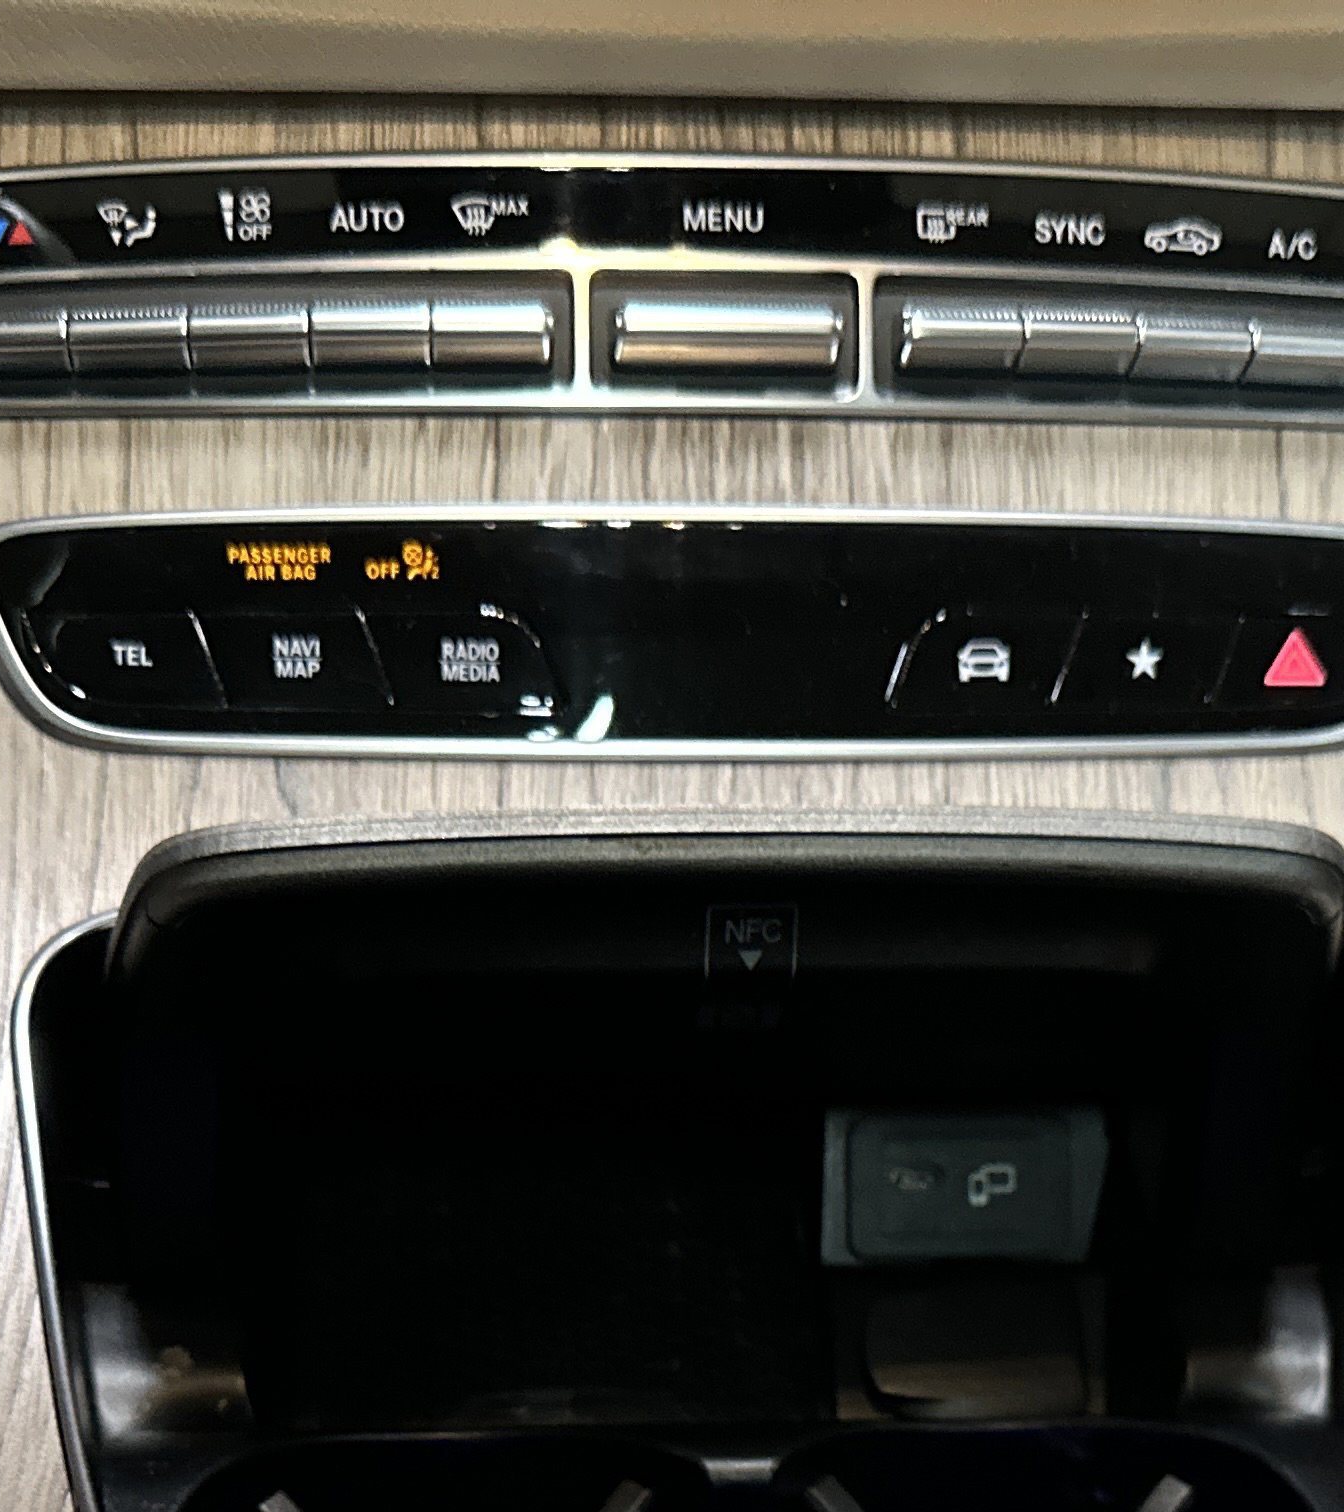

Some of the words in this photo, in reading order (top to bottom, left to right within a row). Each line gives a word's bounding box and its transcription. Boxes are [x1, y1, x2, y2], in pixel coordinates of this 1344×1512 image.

[492, 195, 529, 216] MAX
[330, 202, 405, 233] AUTO
[681, 202, 764, 233] MENU
[237, 223, 272, 241] OFF
[1035, 213, 1106, 247] SYNC
[1268, 229, 1318, 261] A/C
[227, 544, 332, 565] PASSENGER
[246, 564, 276, 581] AIR
[282, 564, 317, 581] BAG
[365, 560, 400, 580] OFF
[111, 641, 152, 667] TEL
[273, 635, 321, 658] NAVI
[442, 638, 500, 662] RADIO
[275, 660, 321, 679] MAP
[441, 663, 500, 683] MEDIA
[724, 918, 783, 945] NFC
